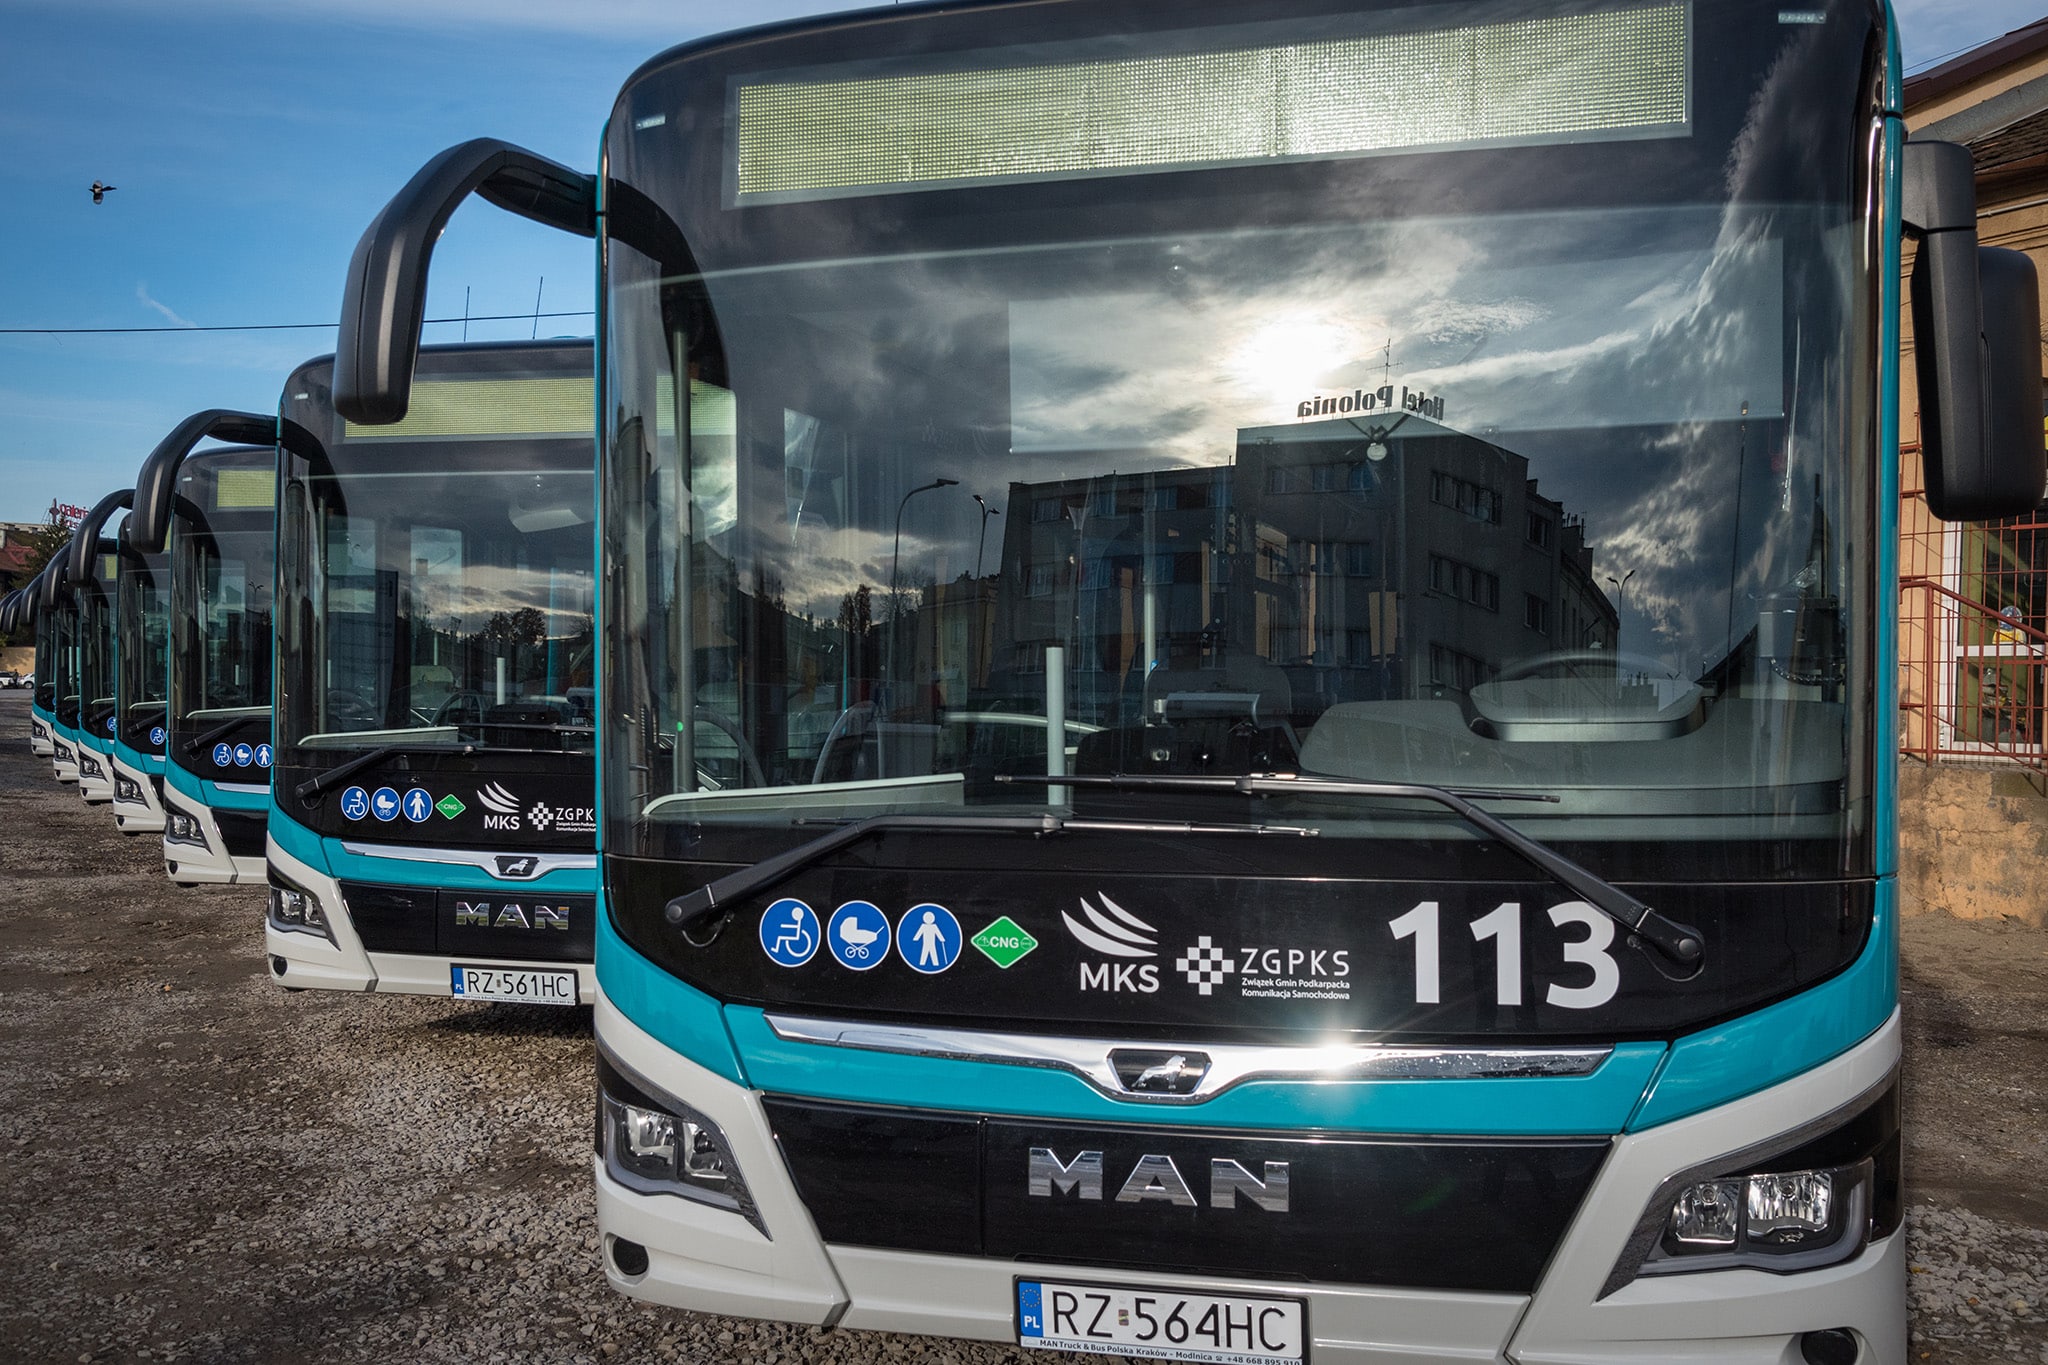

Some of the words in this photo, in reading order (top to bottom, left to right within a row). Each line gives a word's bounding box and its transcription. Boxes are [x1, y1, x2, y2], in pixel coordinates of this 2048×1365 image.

[484, 815, 520, 830] MKS
[555, 808, 594, 821] ZGPK
[456, 902, 570, 930] MAN
[990, 936, 1019, 949] CNG
[1388, 901, 1620, 1009] 113
[1241, 948, 1350, 976] ZGPKS
[467, 971, 495, 994] RZ
[503, 973, 568, 998] 561HC
[1080, 962, 1160, 993] MKS
[1242, 977, 1275, 988] Związek
[1275, 978, 1298, 987] Gmin
[1298, 979, 1350, 990] Podkarpacka
[1242, 988, 1291, 999] Komunikacja
[1292, 989, 1350, 1000] Samochodowa
[1029, 1147, 1289, 1212] MAN
[1024, 1316, 1040, 1329] PL
[1052, 1291, 1113, 1338] RZ
[1135, 1297, 1286, 1351] 564HC
[1040, 1339, 1058, 1348] MAN
[1060, 1341, 1082, 1350] Truck
[1091, 1343, 1106, 1352] Bus
[1107, 1345, 1134, 1354] Polska
[1136, 1347, 1168, 1358] Kraków
[1175, 1351, 1213, 1361] Modlnica
[1227, 1355, 1244, 1364] +48
[1246, 1357, 1262, 1365] 668
